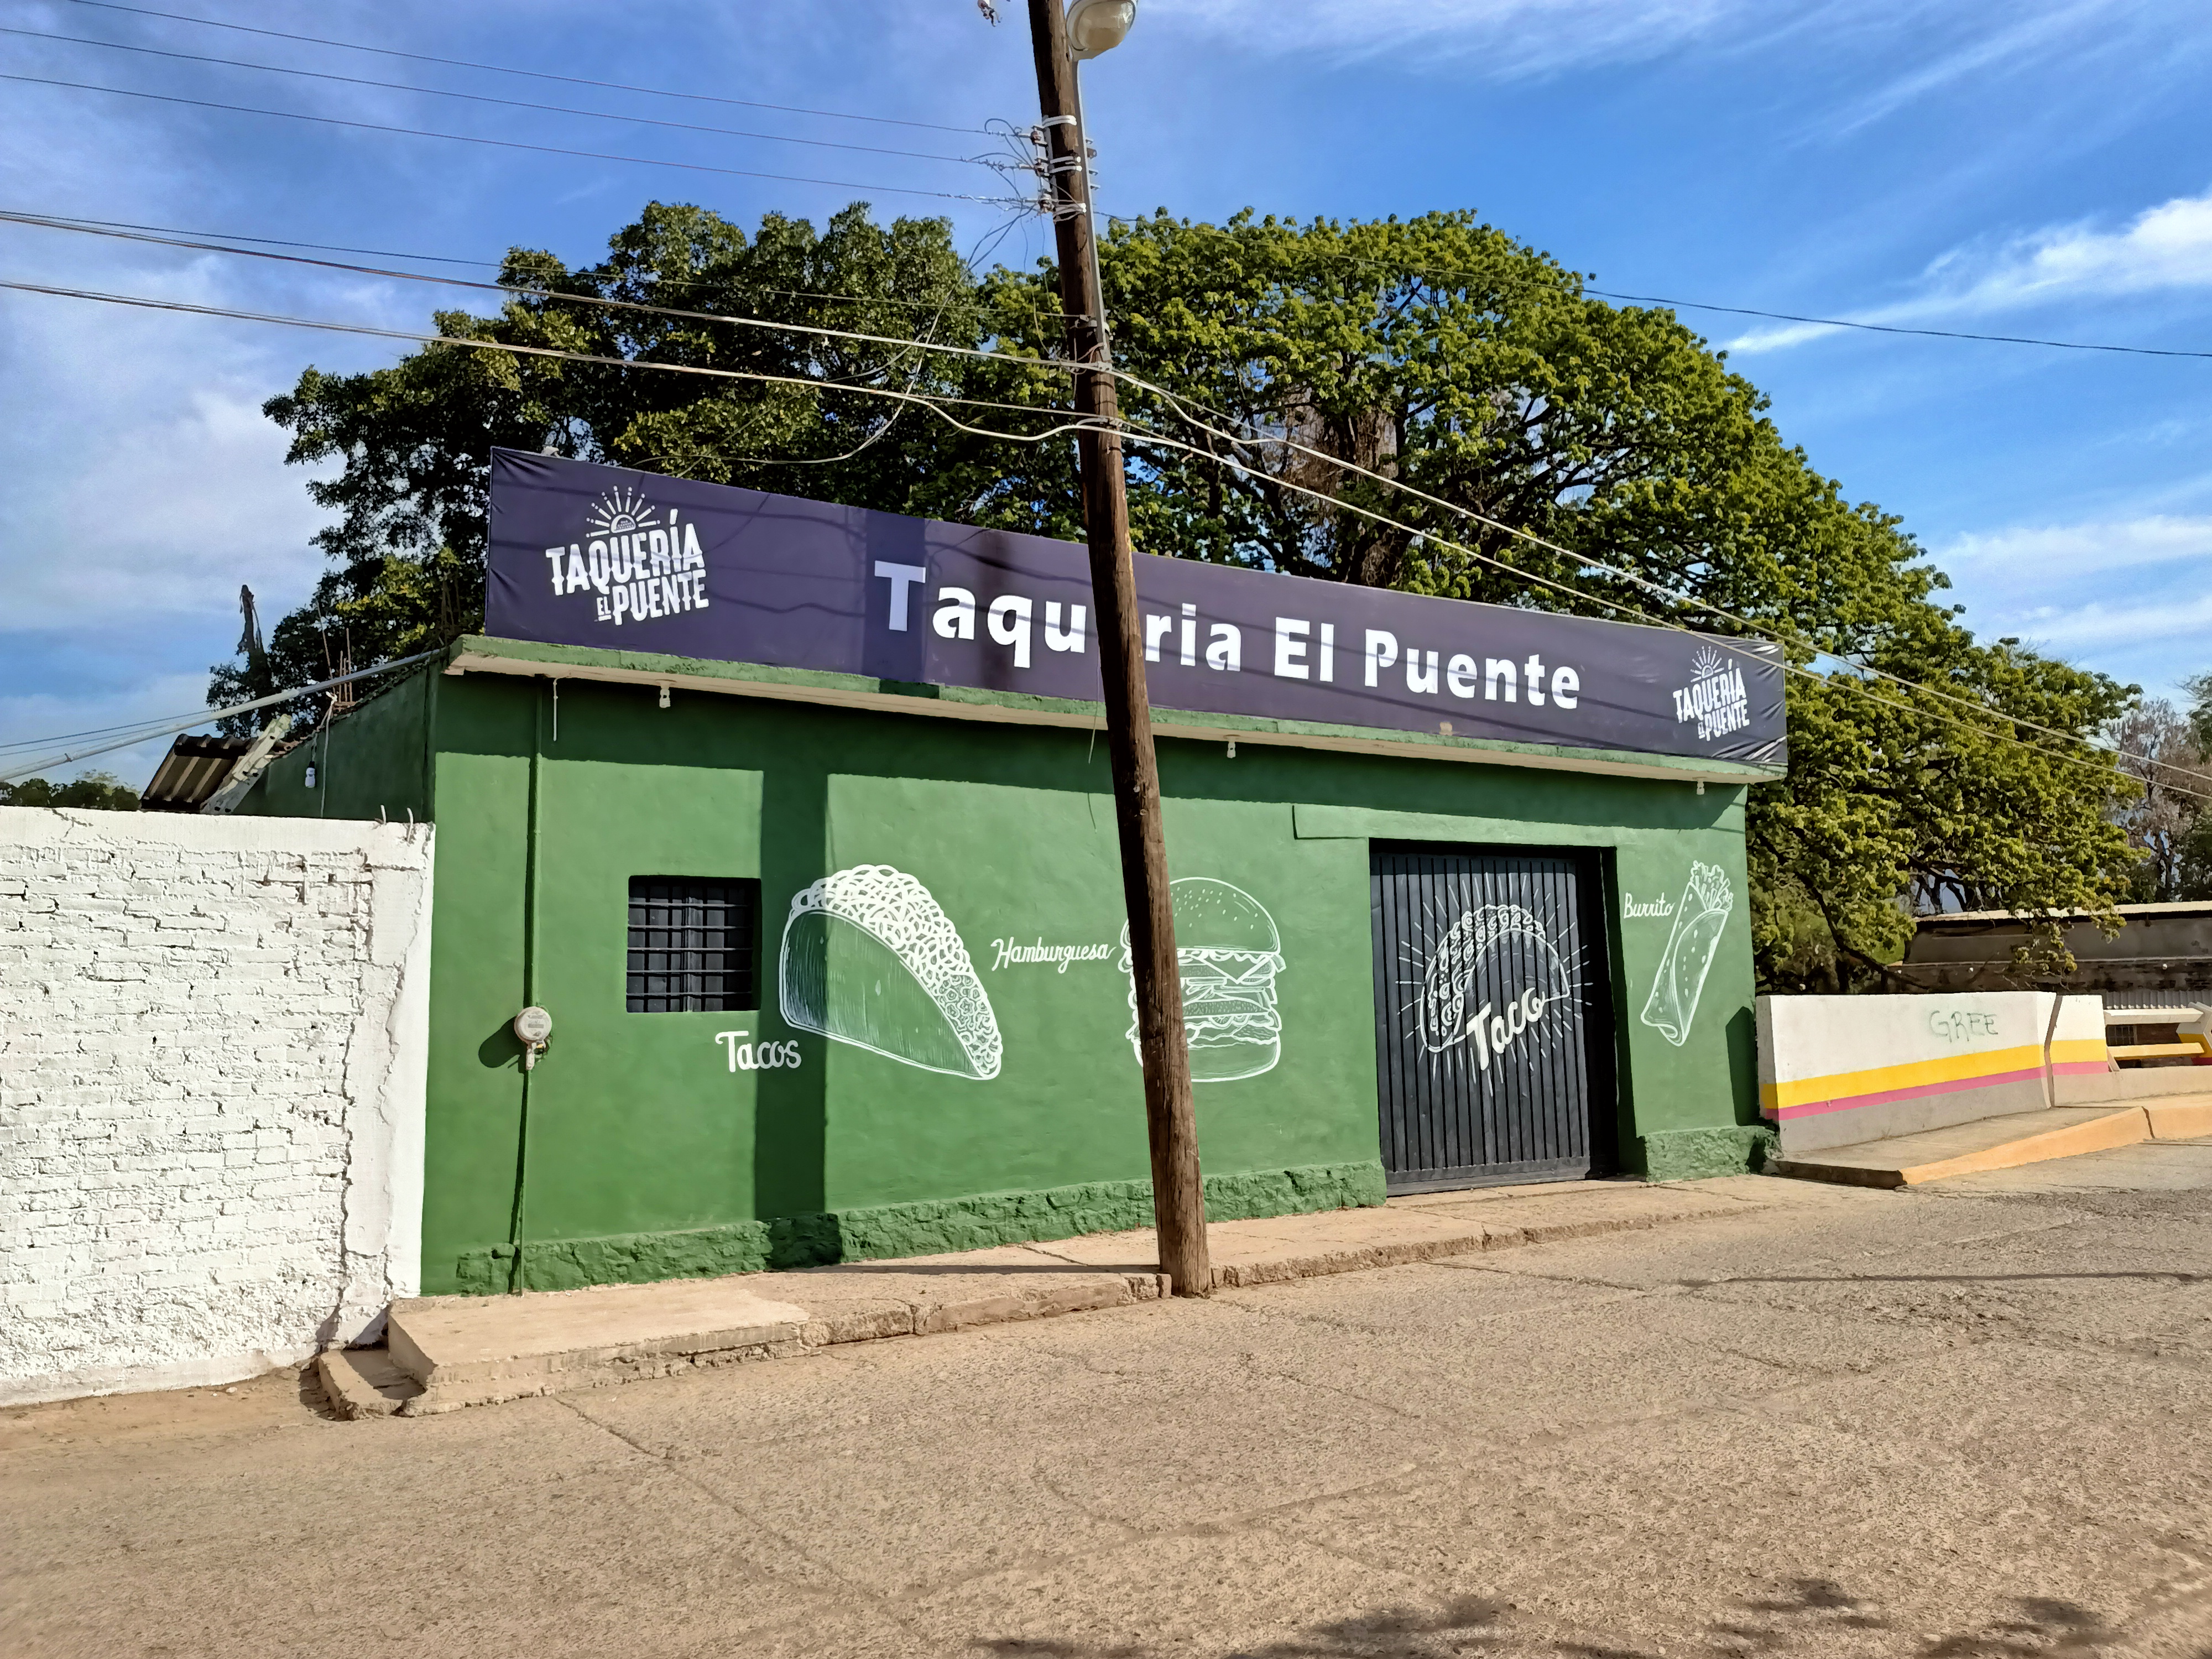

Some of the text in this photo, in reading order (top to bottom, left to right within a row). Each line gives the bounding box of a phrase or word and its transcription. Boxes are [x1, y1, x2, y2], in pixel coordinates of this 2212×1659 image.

[545, 508, 706, 596] TAQUERÍA
[596, 569, 709, 625] EL PUENTE
[874, 560, 1580, 709] Taquria El Puente
[1673, 658, 1746, 723] TAQUERÍA
[1704, 699, 1750, 742] PUENTE
[1623, 891, 1675, 919] Burrito
[990, 937, 1117, 974] Hamburguesa
[714, 1030, 802, 1073] Tacos
[1466, 987, 1548, 1071] Taco
